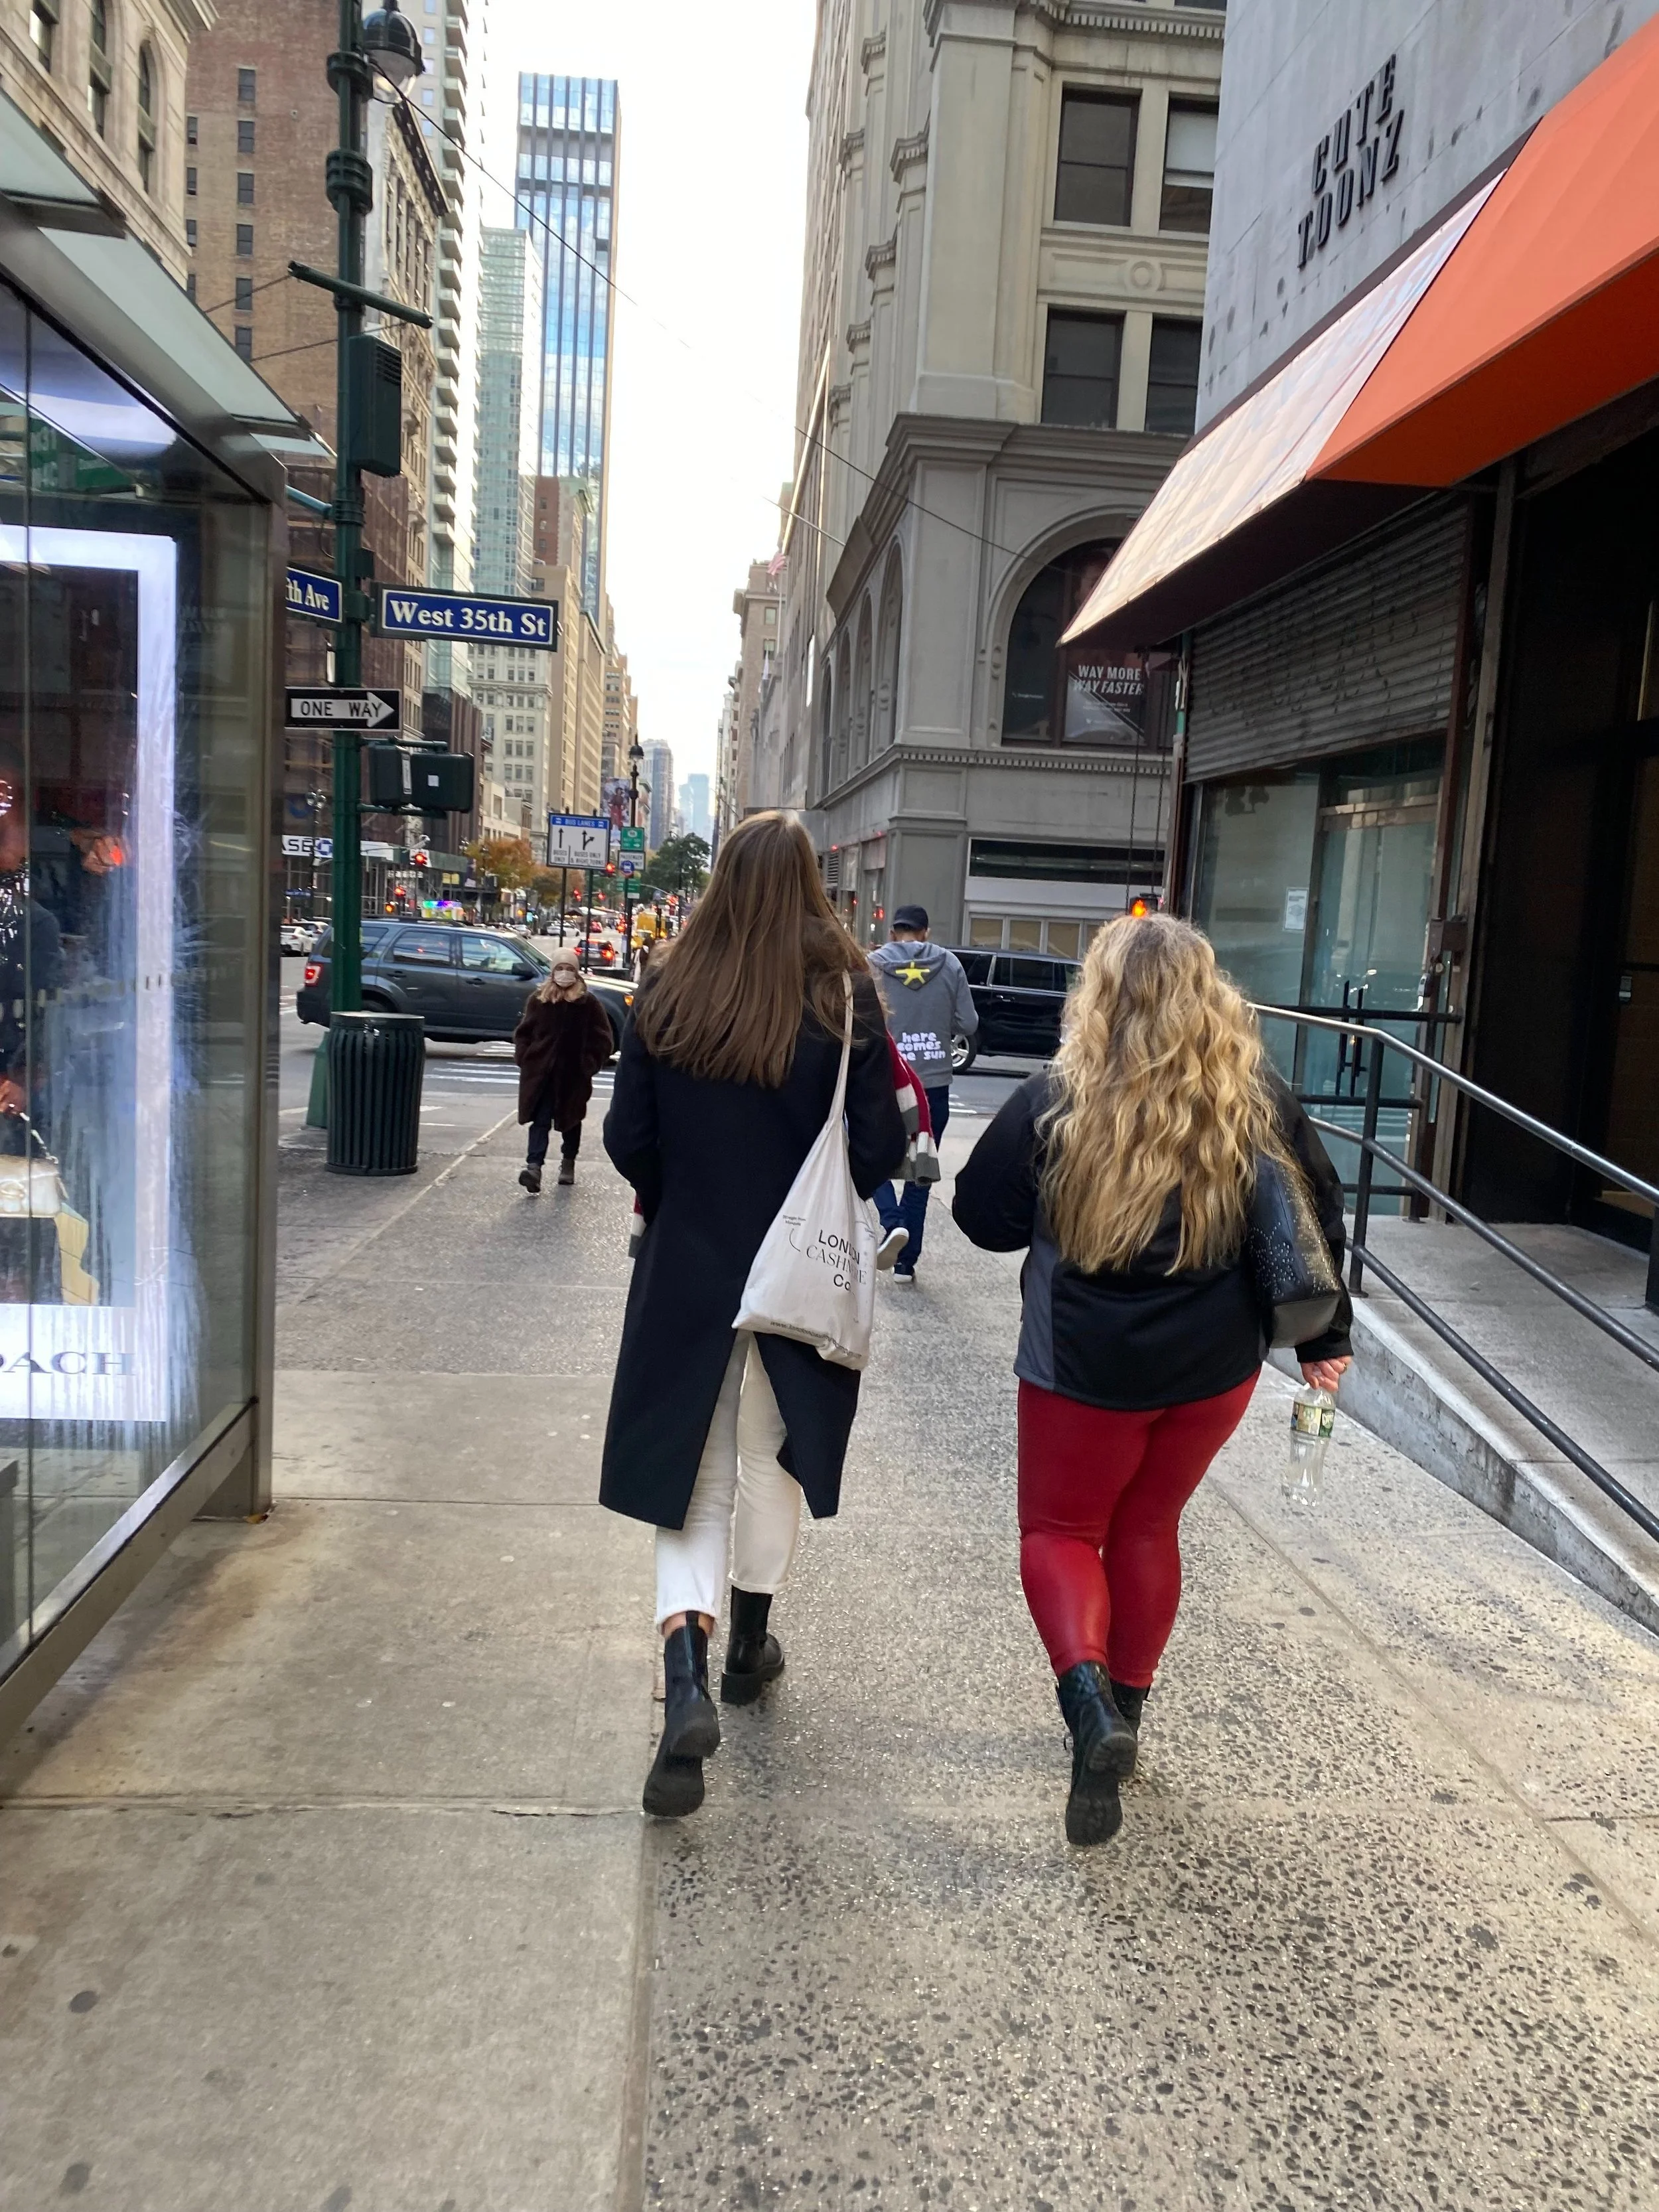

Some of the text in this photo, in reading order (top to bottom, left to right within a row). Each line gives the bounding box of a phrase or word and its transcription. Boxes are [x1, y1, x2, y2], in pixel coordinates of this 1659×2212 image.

[1312, 54, 1397, 196] CUTE
[1298, 109, 1405, 269] TOONZ
[285, 577, 330, 611] th Ave
[390, 600, 546, 636] West 35th St
[1078, 665, 1142, 681] WAY MORE
[1073, 680, 1145, 696] WAY FASTER
[301, 701, 382, 717] ONE WAY
[577, 819, 596, 828] LANES
[282, 838, 314, 852] SE
[902, 1032, 937, 1043] here
[896, 1041, 942, 1052] comes
[900, 1051, 946, 1061] he sun
[0, 1351, 137, 1376] ACH
